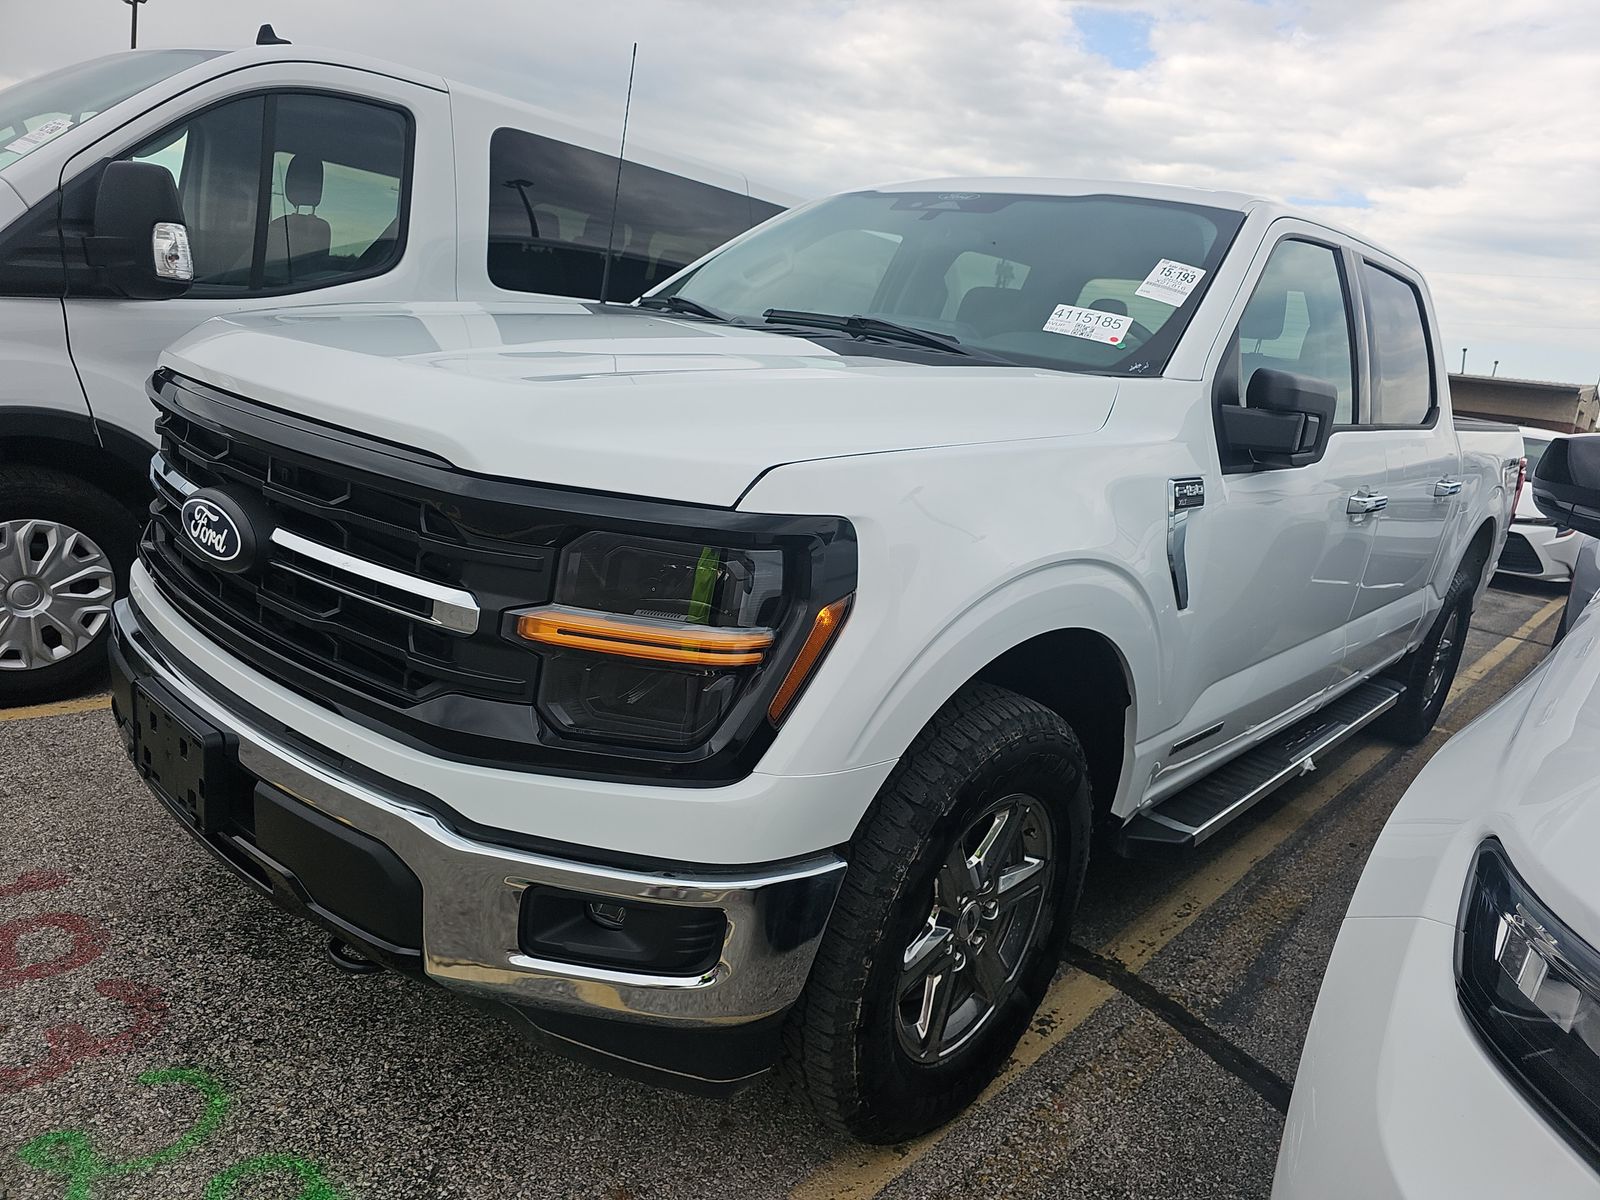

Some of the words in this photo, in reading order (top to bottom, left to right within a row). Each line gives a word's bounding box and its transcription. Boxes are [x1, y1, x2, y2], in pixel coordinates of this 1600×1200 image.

[1159, 266, 1196, 284] 15:193
[1054, 308, 1123, 330] 4115185
[190, 505, 228, 553] Ford
